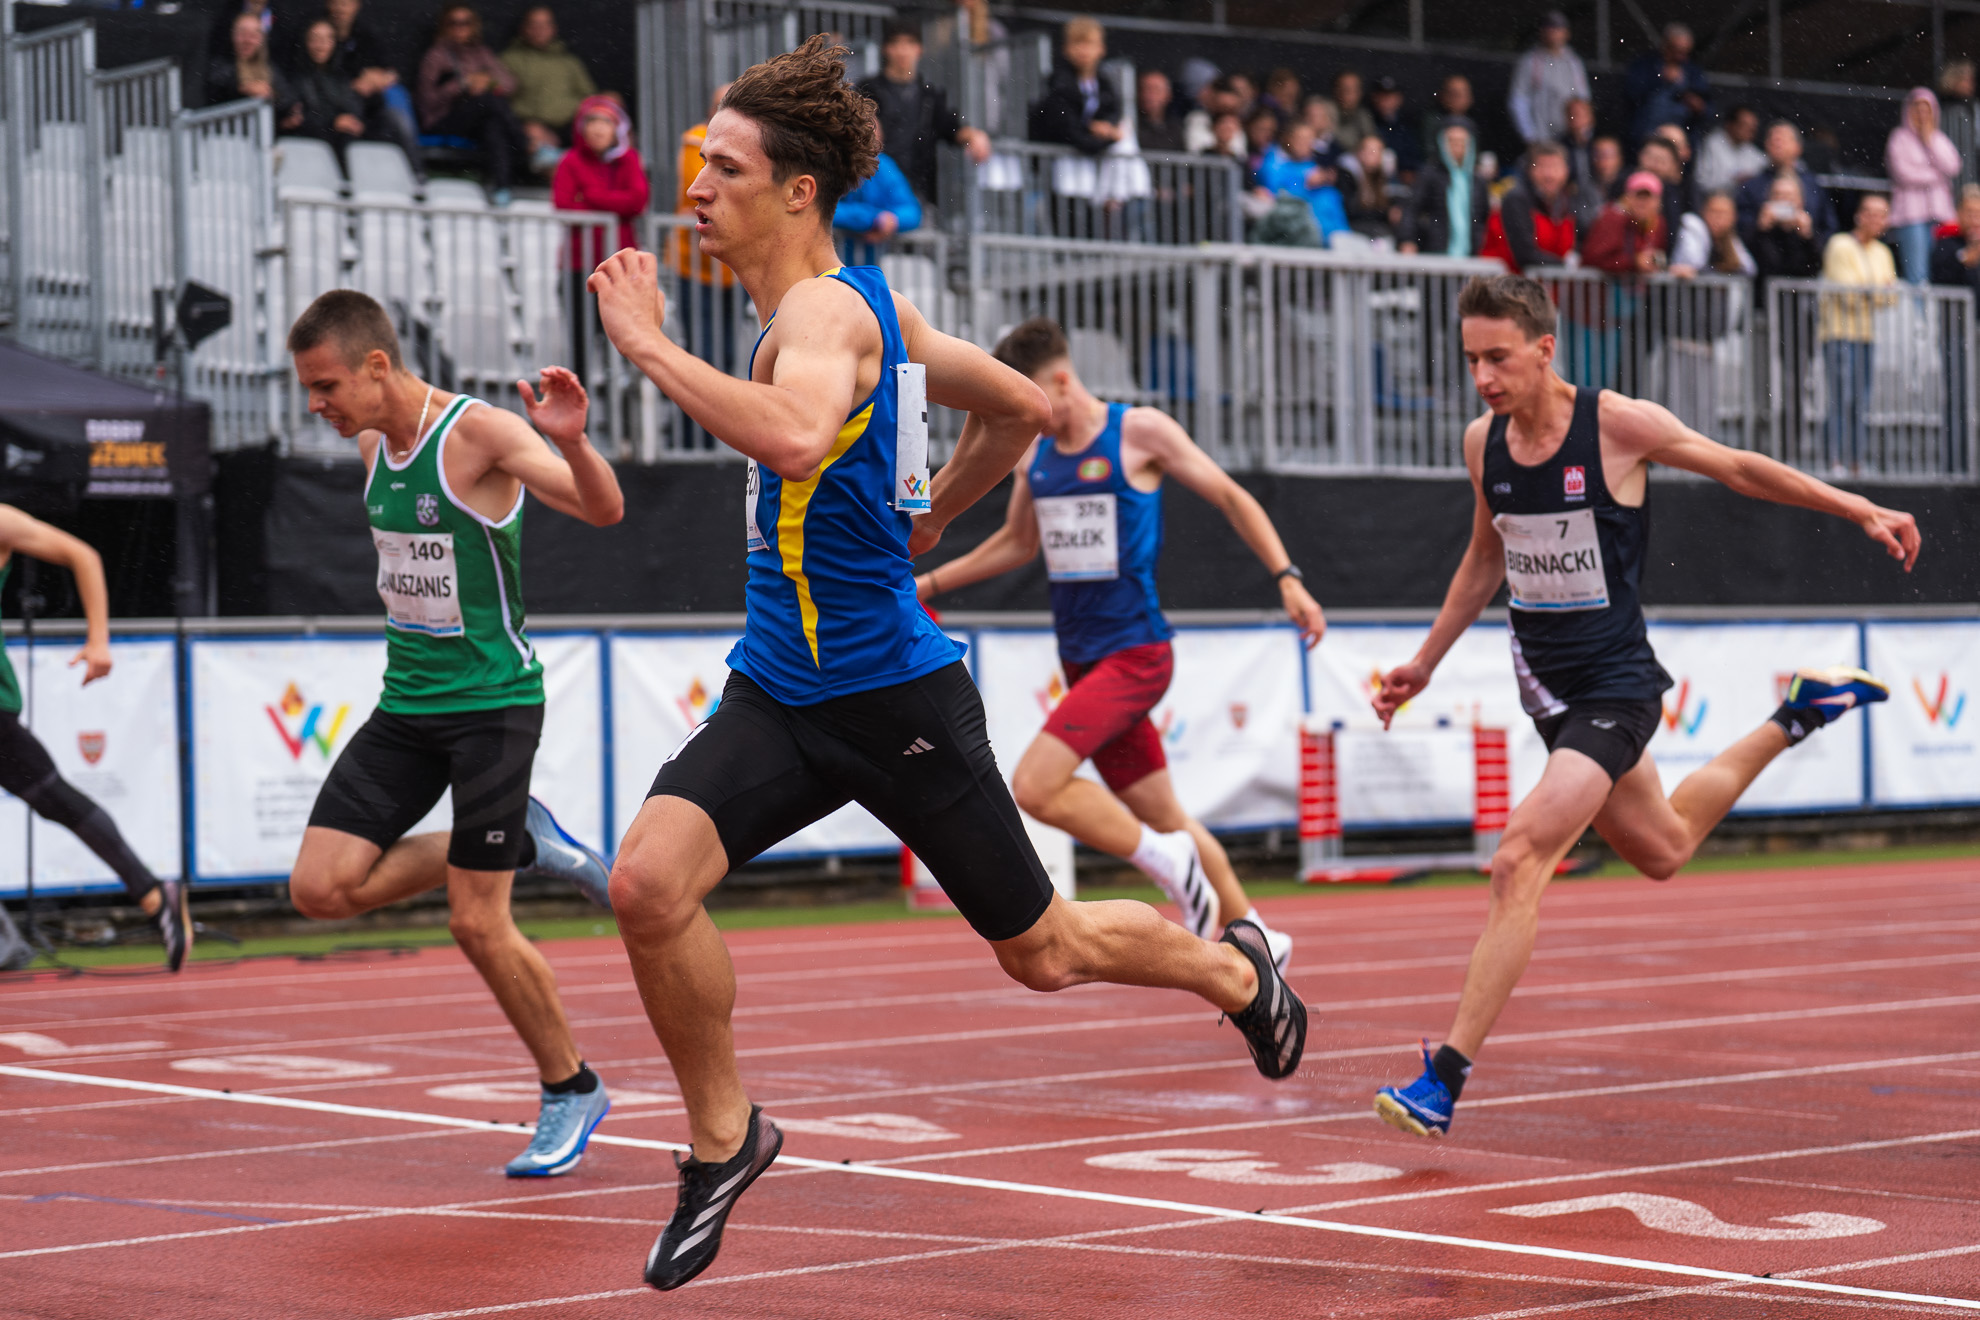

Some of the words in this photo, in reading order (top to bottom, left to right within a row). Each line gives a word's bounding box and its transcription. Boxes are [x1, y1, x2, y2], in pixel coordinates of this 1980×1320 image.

[1555, 519, 1570, 539] 7
[408, 540, 444, 560] 140
[1507, 548, 1597, 574] BIERNACKI
[380, 569, 451, 598] ANUSZANIS
[1085, 1148, 1404, 1186] 3
[1488, 1191, 1888, 1242] 2
